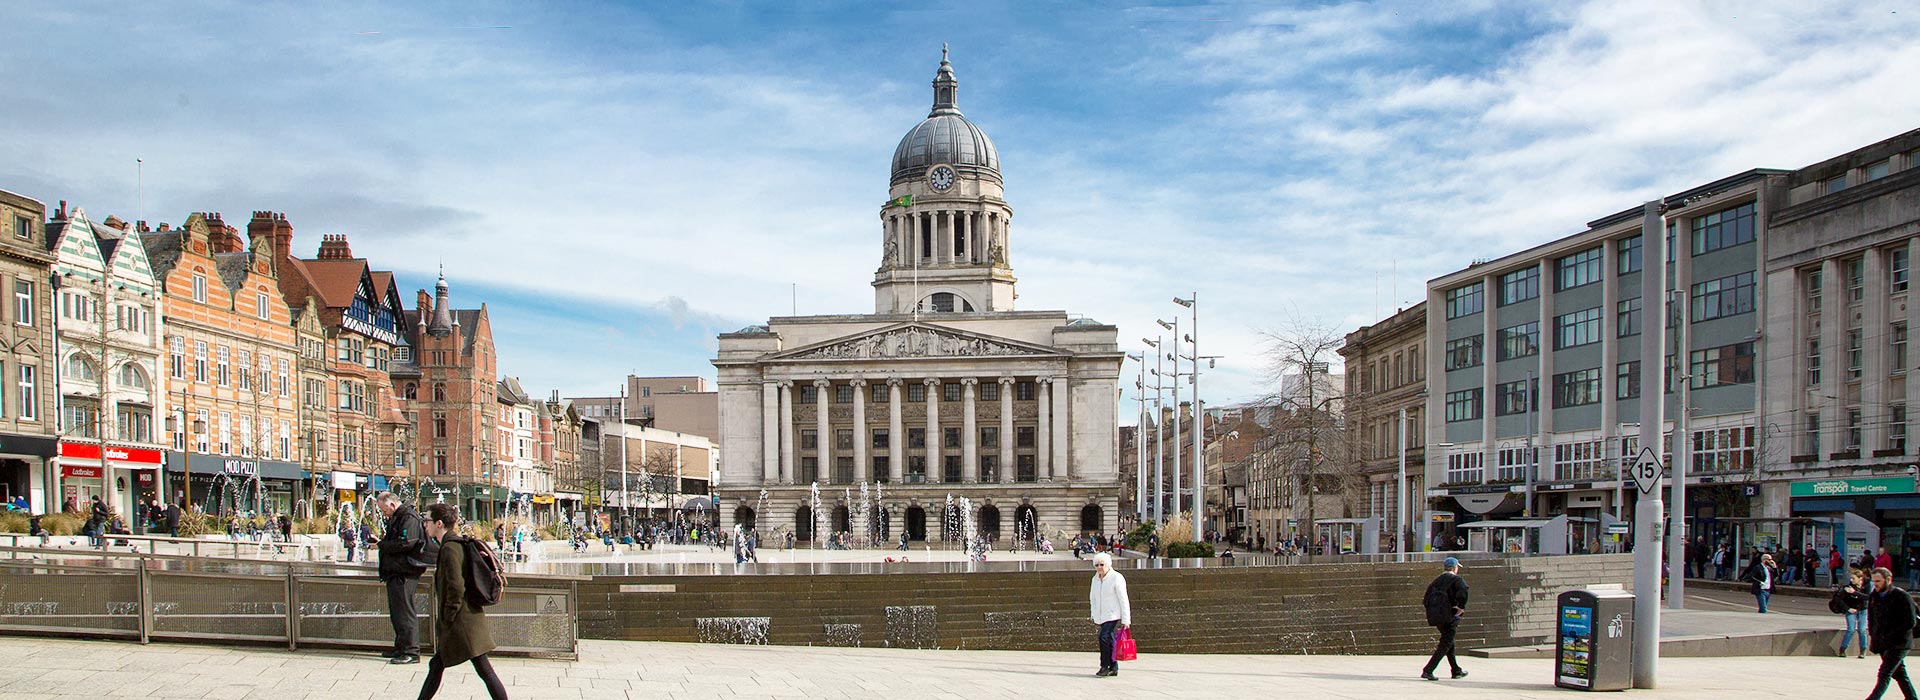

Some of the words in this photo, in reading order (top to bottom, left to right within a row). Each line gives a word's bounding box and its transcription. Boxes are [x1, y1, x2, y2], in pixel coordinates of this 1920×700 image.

[72, 468, 95, 476] Ladbrokes
[225, 460, 240, 474] MOD
[240, 461, 257, 475] PIZZA
[1638, 462, 1654, 479] 15
[140, 473, 152, 482] MOD
[1813, 484, 1849, 495] Transport
